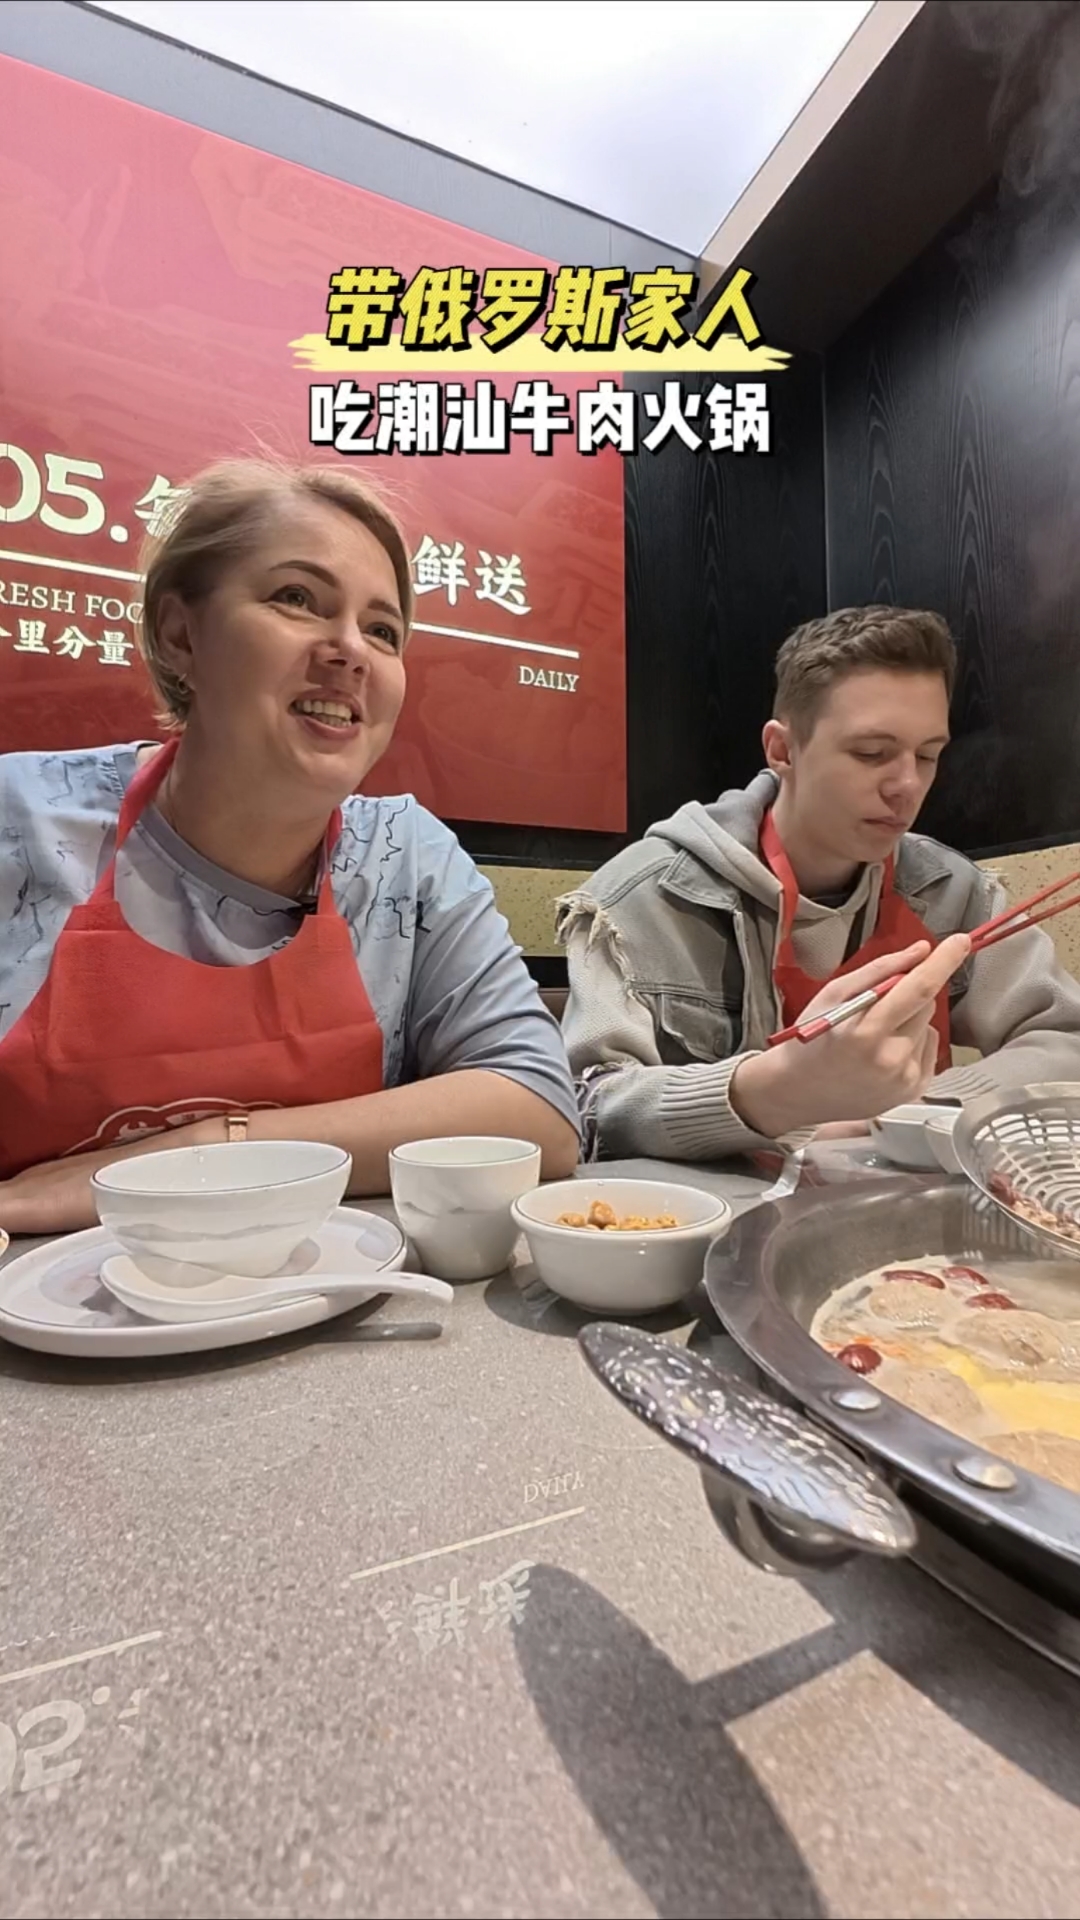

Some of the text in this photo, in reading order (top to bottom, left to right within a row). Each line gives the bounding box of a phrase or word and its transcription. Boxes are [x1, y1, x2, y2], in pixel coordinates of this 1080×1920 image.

[411, 534, 532, 615] 鲜送
[0, 618, 134, 666] 里分量
[519, 665, 580, 692] DAILY
